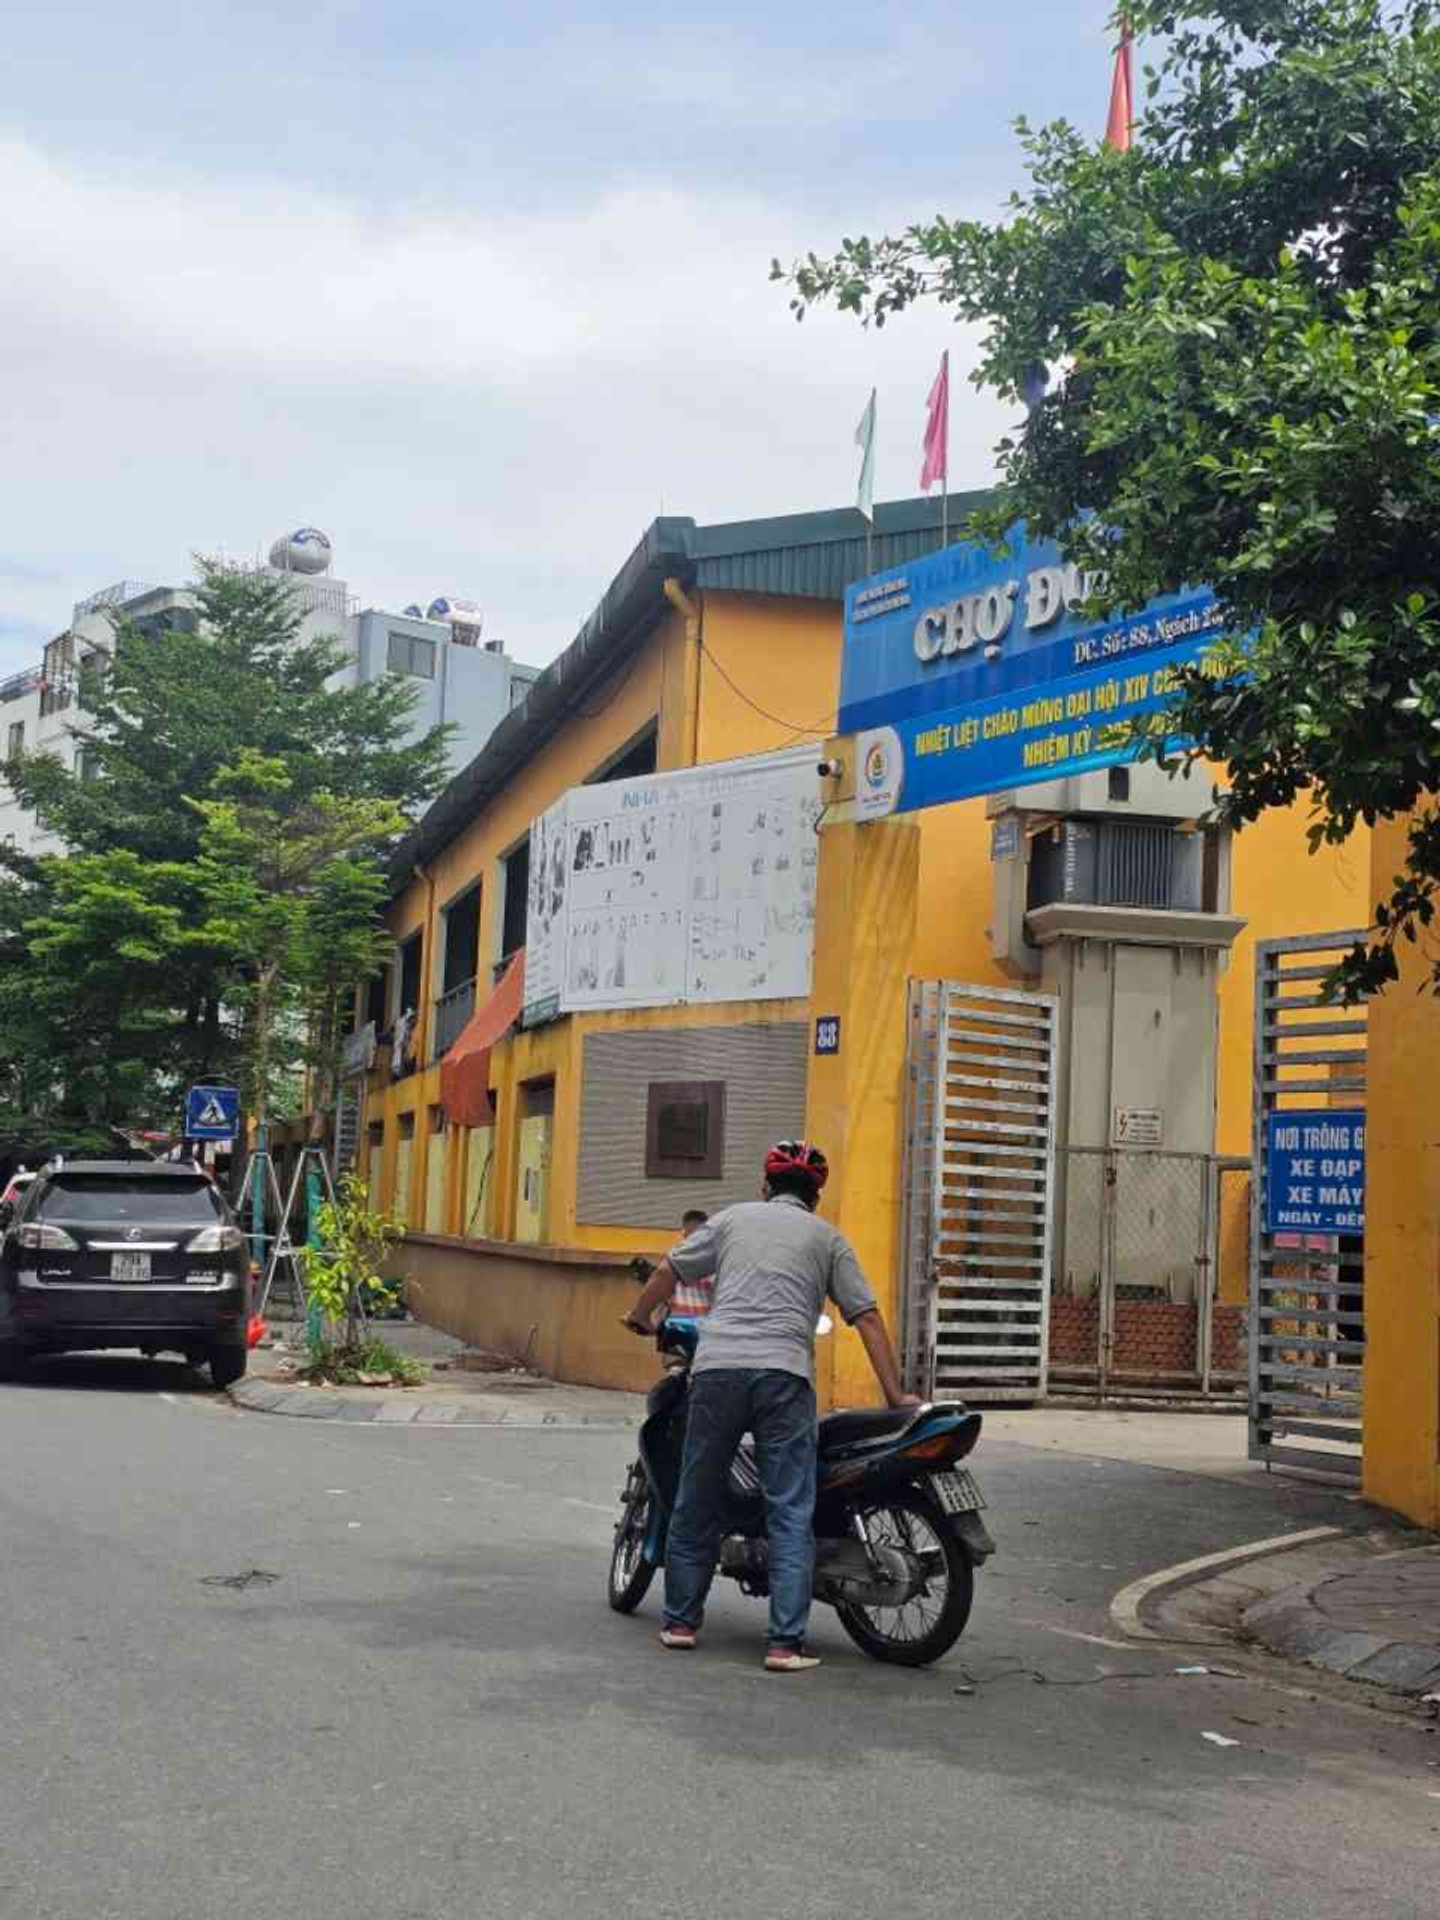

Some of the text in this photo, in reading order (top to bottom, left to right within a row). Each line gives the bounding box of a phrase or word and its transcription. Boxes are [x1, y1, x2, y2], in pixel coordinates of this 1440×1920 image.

[914, 579, 1020, 662] CHỢ
[915, 723, 950, 757] NHIỆT
[954, 716, 978, 749] LIỆT
[983, 707, 1018, 740] CHÀO
[818, 1022, 837, 1048] 88
[1290, 1159, 1361, 1182] XE ĐẠP
[1288, 1183, 1363, 1205] XE MÁY
